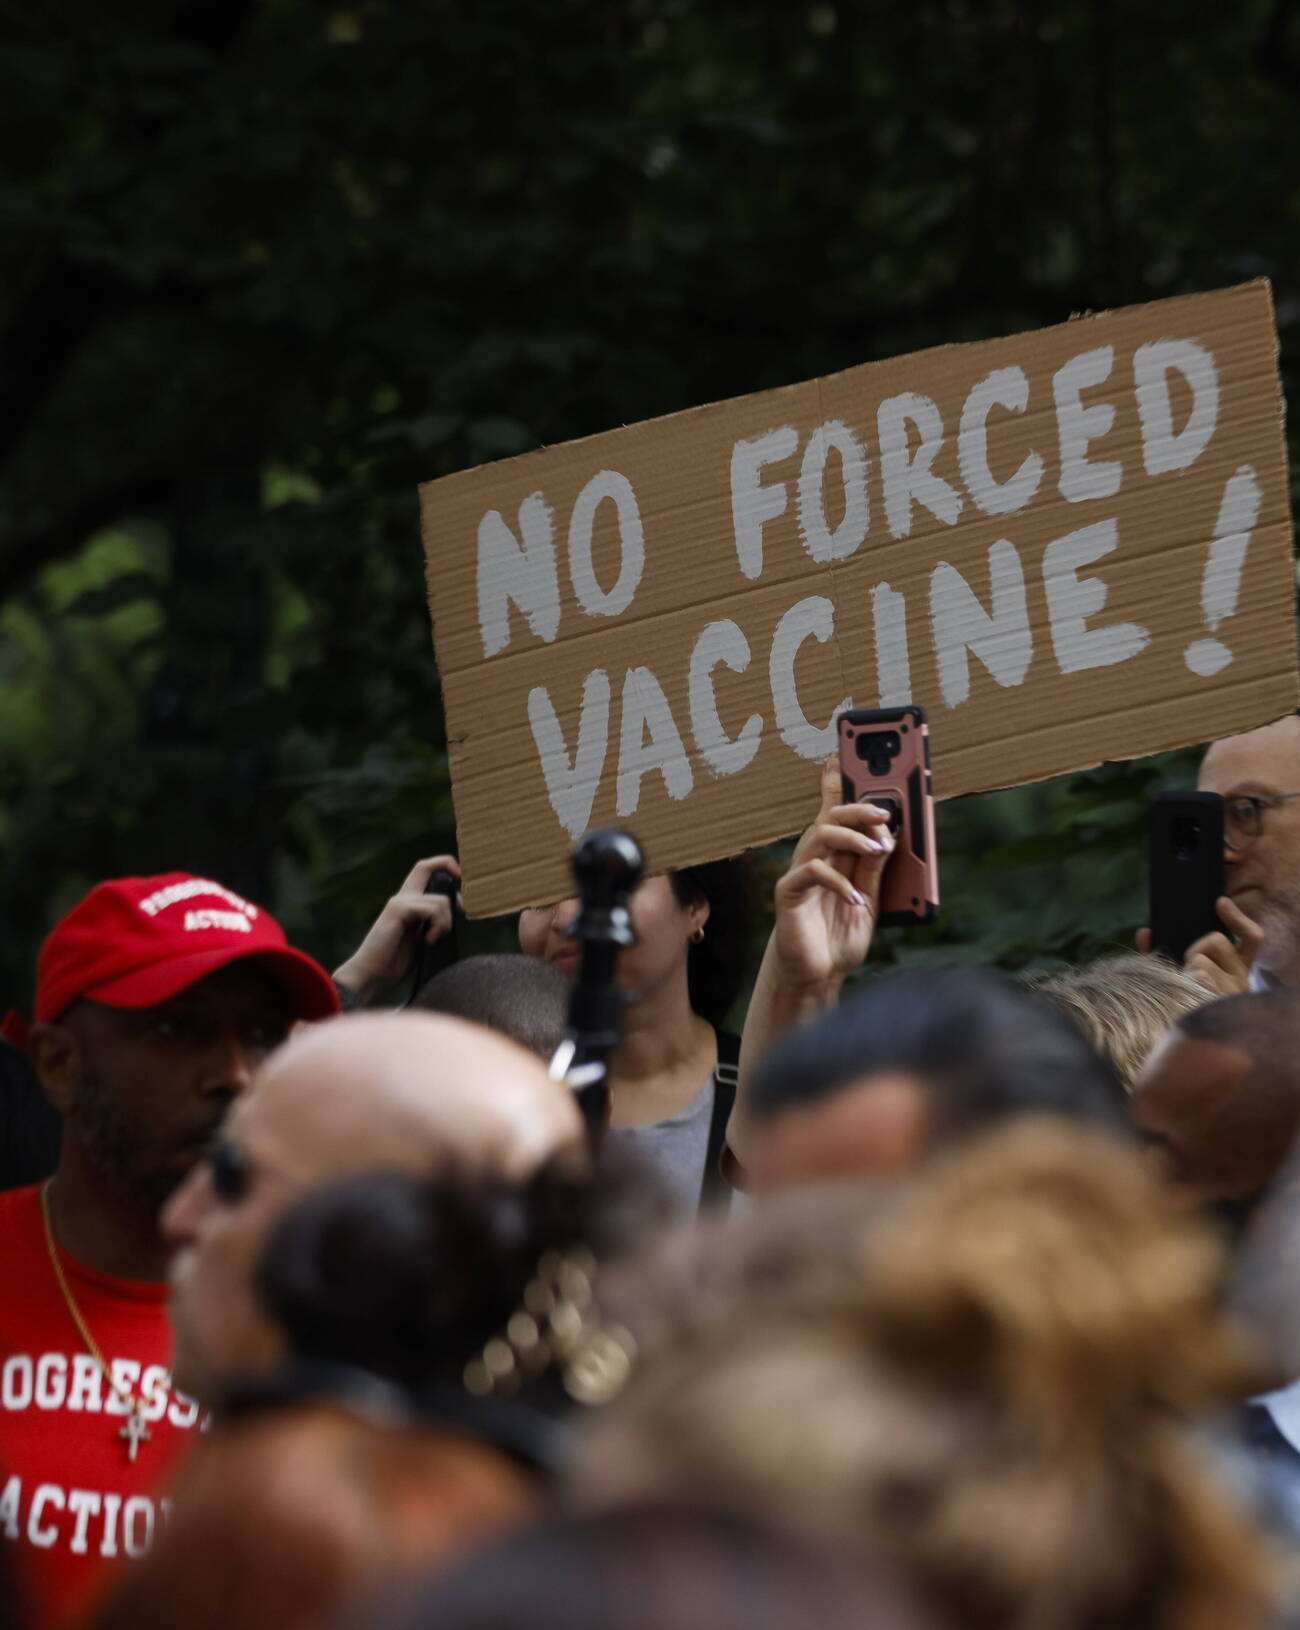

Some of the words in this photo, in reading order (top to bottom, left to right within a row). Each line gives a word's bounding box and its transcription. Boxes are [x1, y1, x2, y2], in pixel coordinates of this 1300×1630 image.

[475, 470, 646, 660] NO
[730, 338, 1220, 582] FORCED
[526, 517, 1152, 841] VACCINE
[1182, 464, 1263, 677] !
[0, 1474, 174, 1558] ACTIO
